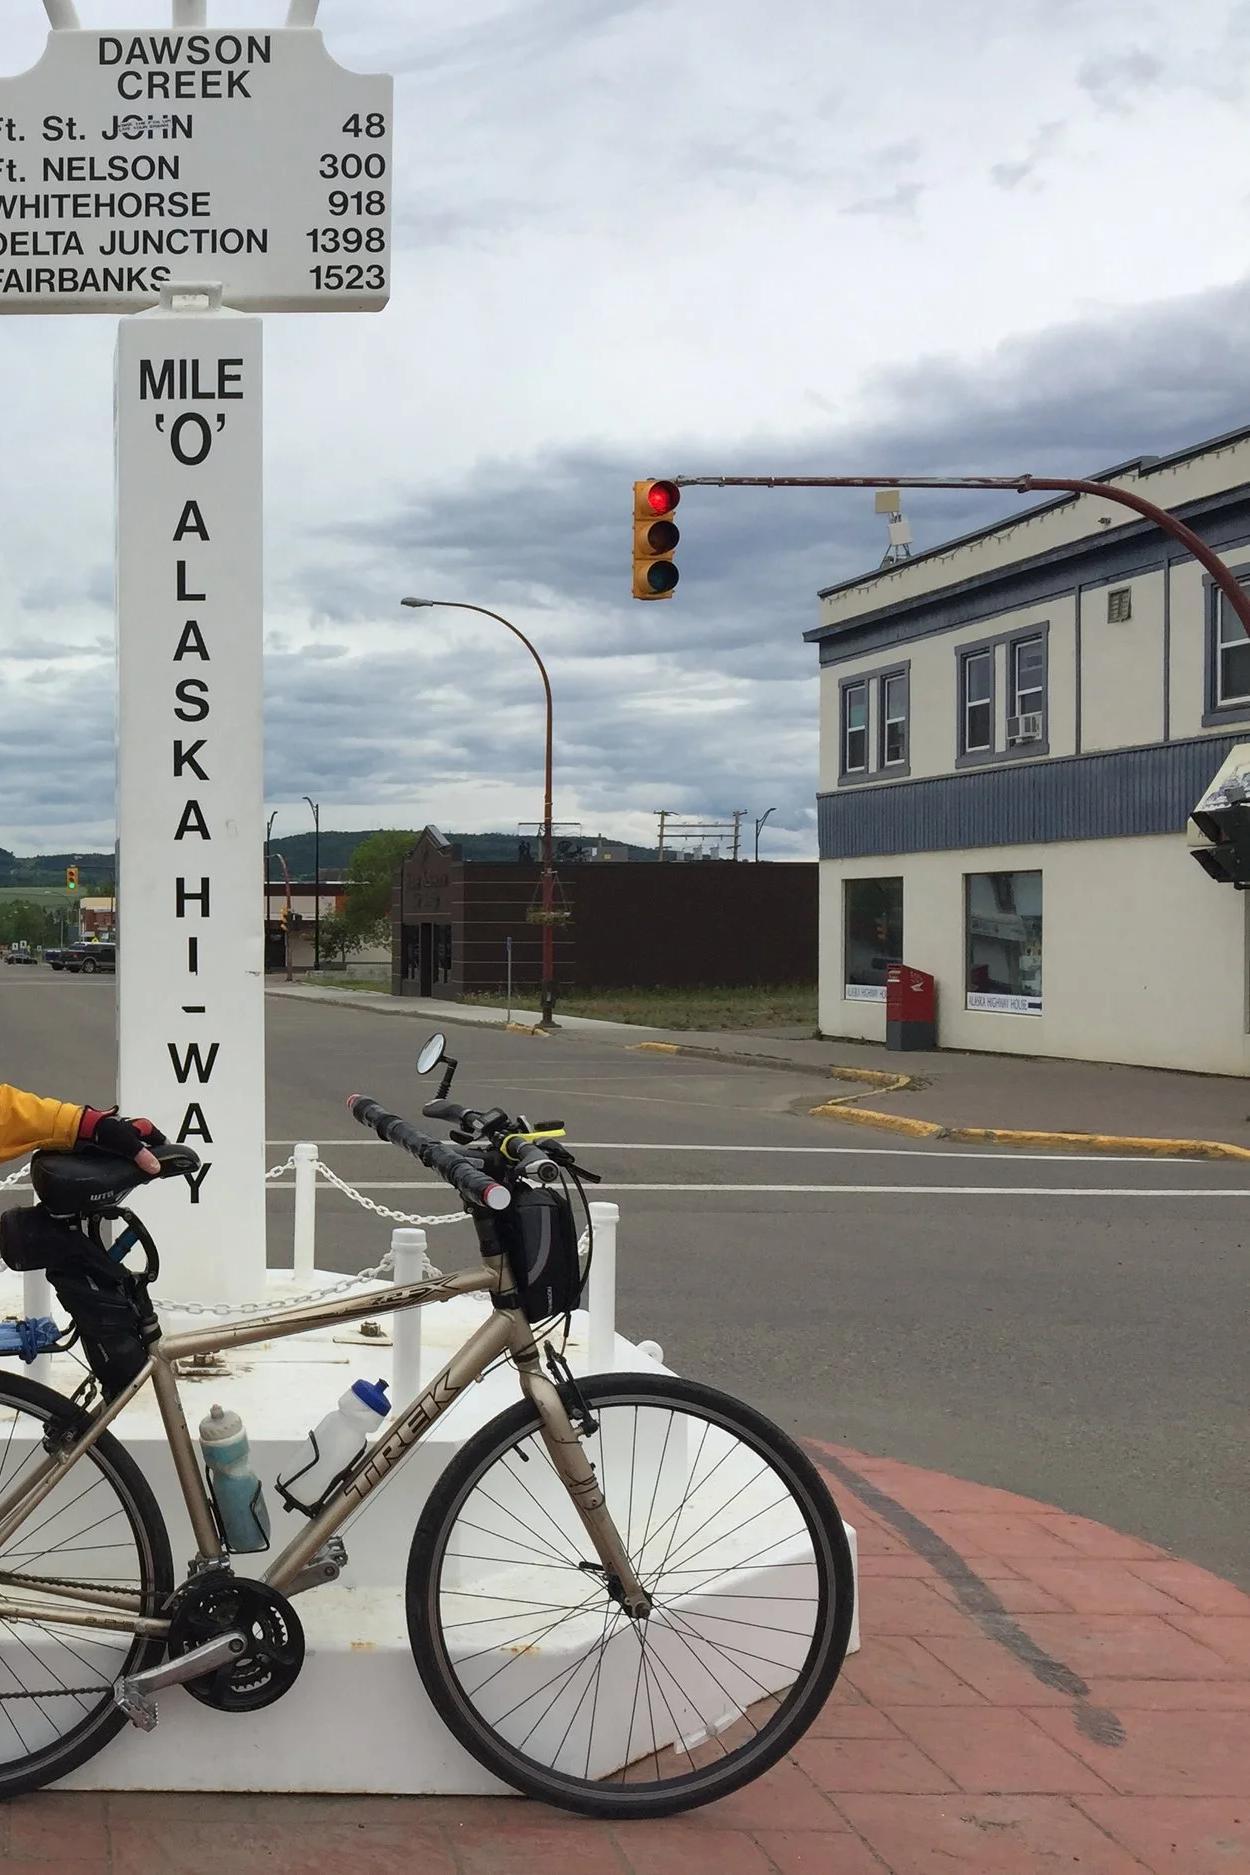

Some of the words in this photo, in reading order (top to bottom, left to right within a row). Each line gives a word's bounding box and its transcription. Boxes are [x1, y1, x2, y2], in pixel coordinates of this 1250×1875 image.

[100, 35, 270, 65] DAWSON
[118, 70, 251, 100] CREEK
[43, 116, 85, 141] St.
[102, 115, 192, 140] JOHN
[343, 113, 385, 138] 48
[43, 155, 179, 181] NELSON
[320, 154, 385, 179] 300
[329, 191, 385, 216] 918
[100, 229, 267, 255] JUNCTION
[307, 228, 385, 253] 1398
[310, 265, 385, 290] 1523
[140, 359, 243, 399] MILE
[173, 501, 211, 840] ALASKA
[343, 1368, 462, 1499] TREK
